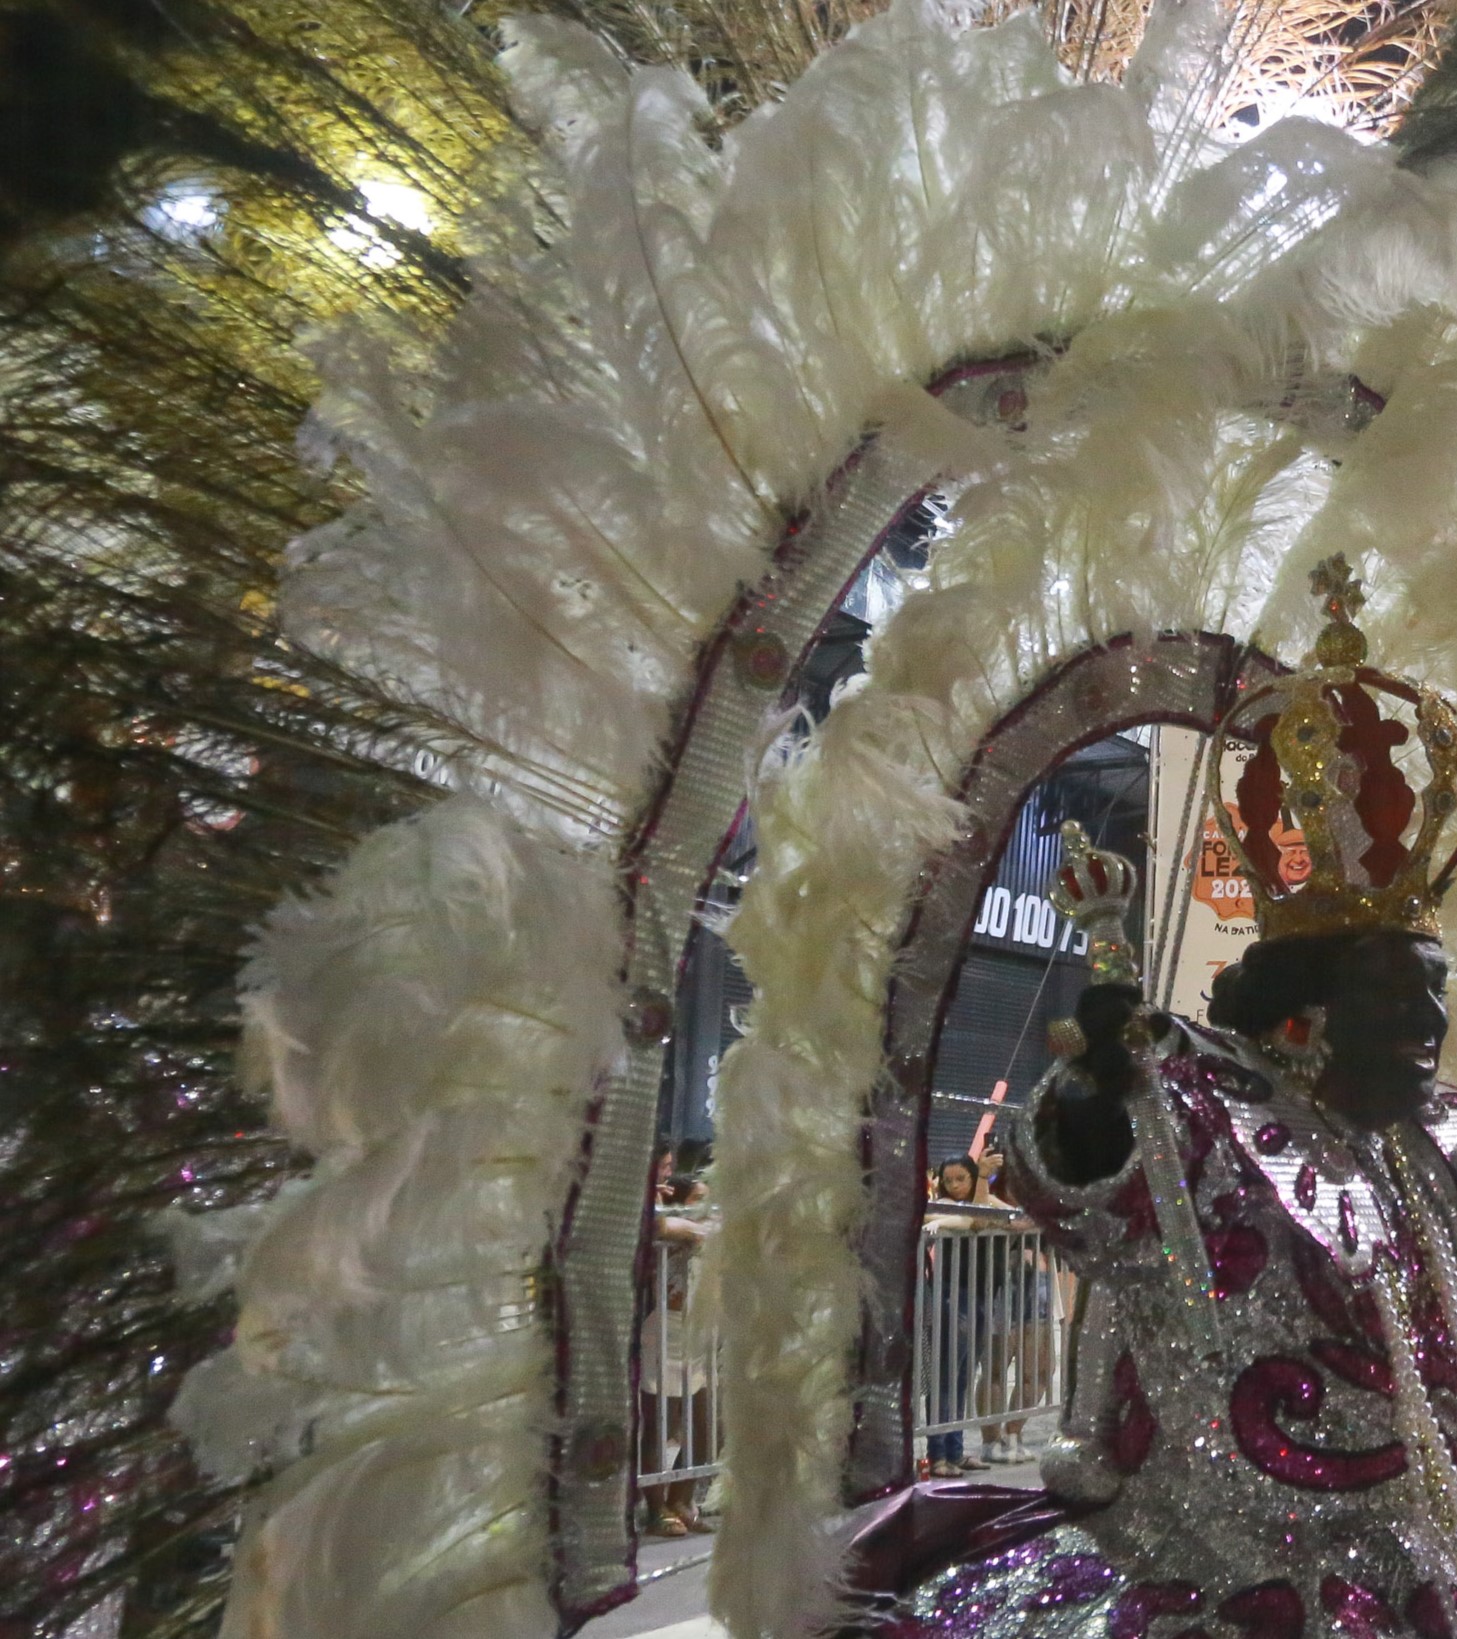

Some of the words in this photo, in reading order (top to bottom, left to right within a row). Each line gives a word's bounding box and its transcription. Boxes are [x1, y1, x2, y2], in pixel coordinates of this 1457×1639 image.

[1211, 879, 1253, 899] 202
[1214, 923, 1228, 934] NA
[1231, 923, 1260, 936] BATI
